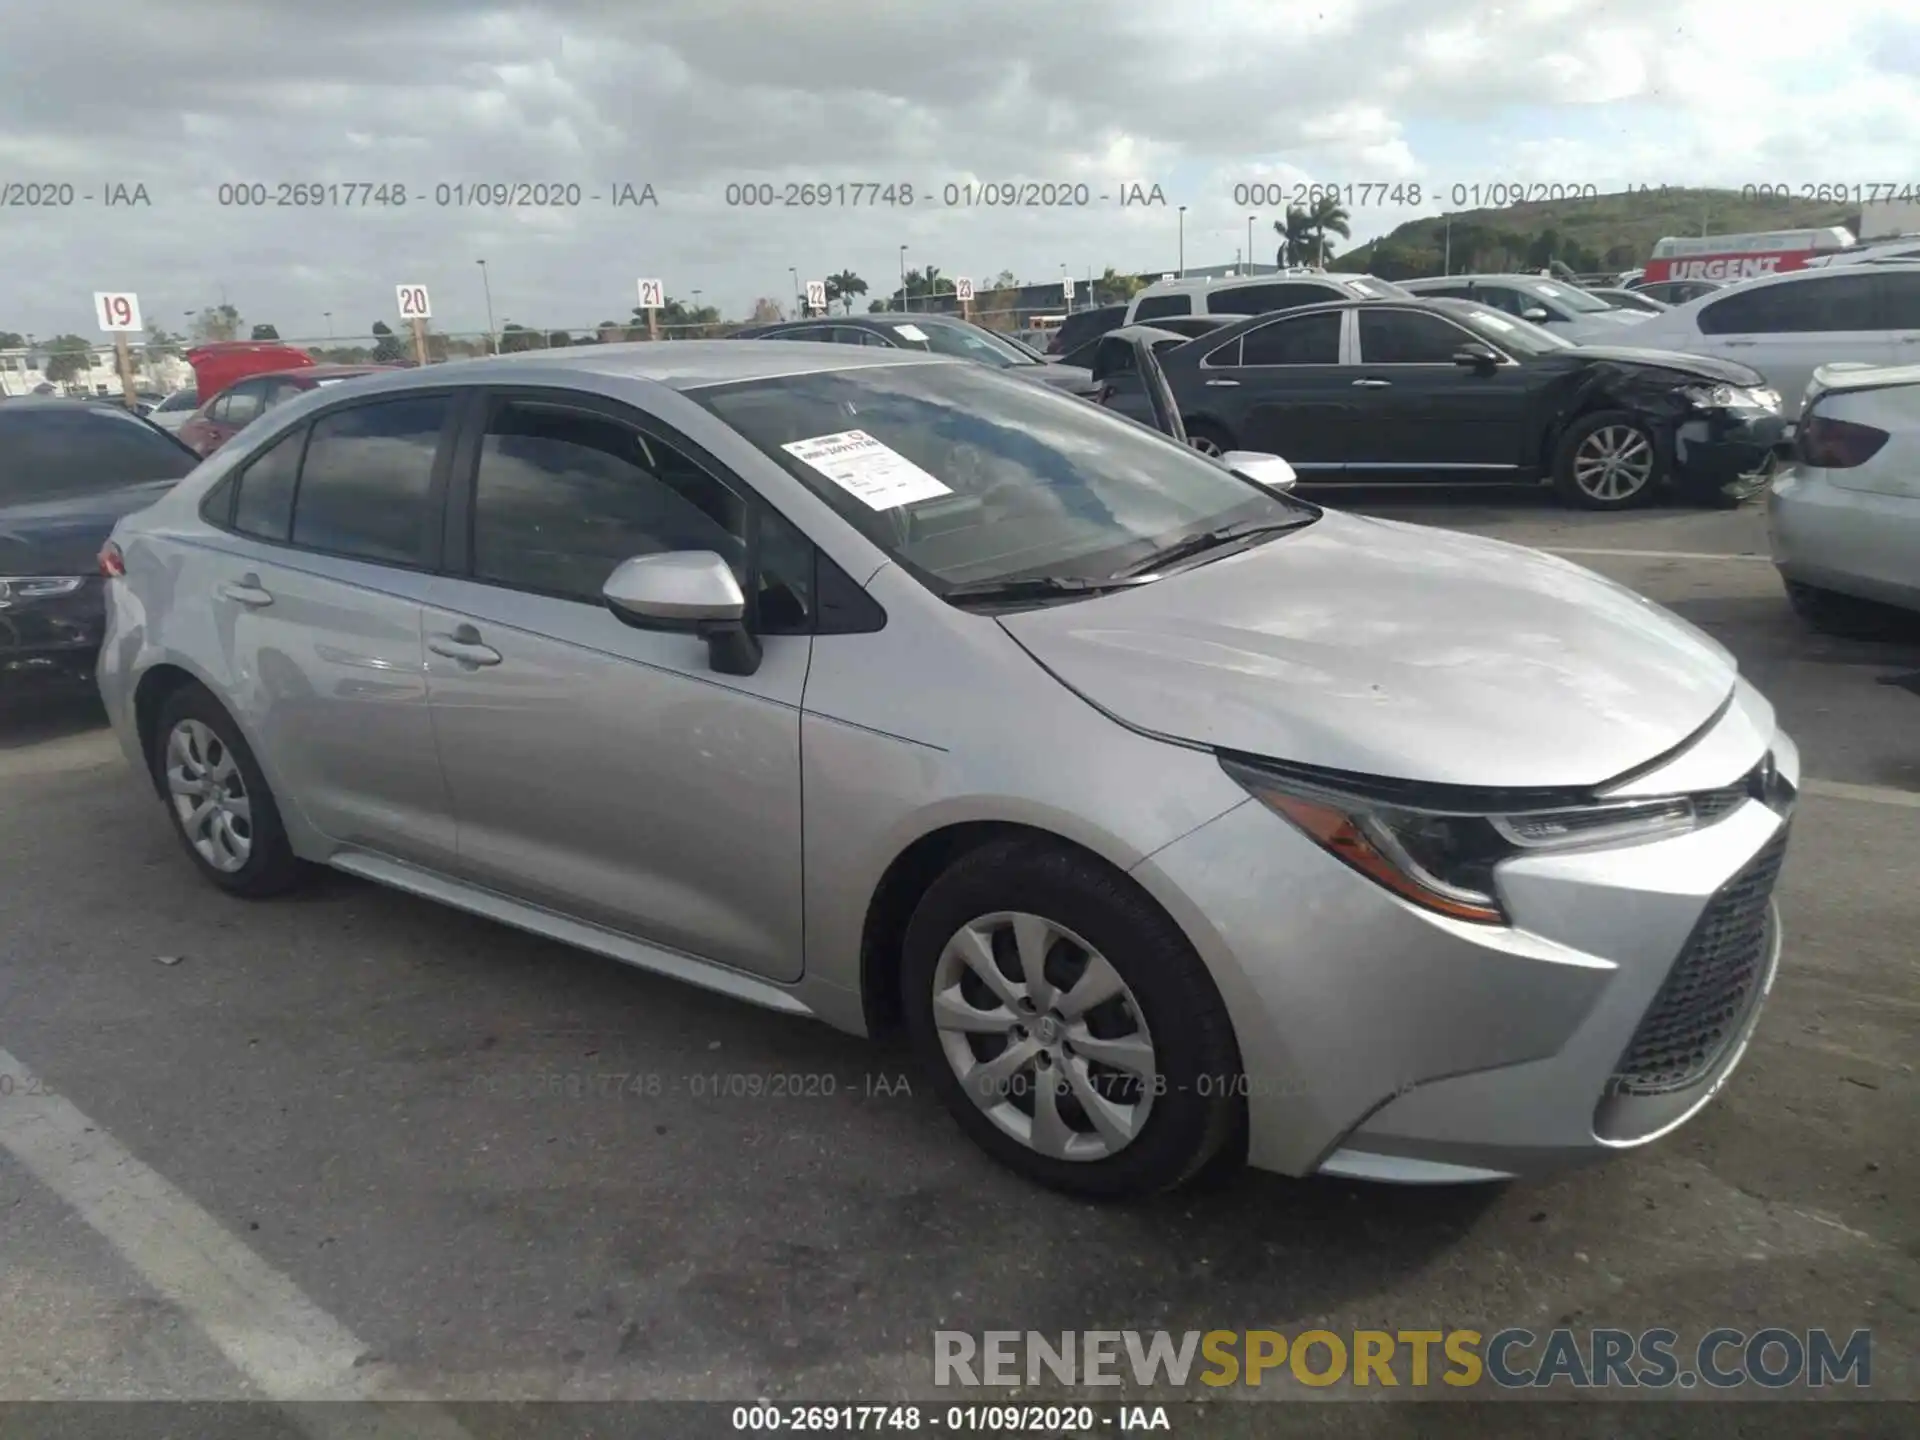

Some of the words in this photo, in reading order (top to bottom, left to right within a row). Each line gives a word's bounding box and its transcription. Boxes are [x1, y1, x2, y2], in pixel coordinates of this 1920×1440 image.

[1669, 257, 1781, 280] URGENT
[642, 282, 660, 305] 21
[810, 285, 825, 305] 22
[958, 278, 972, 300] 23
[102, 296, 132, 326] 19
[400, 287, 427, 315] 20
